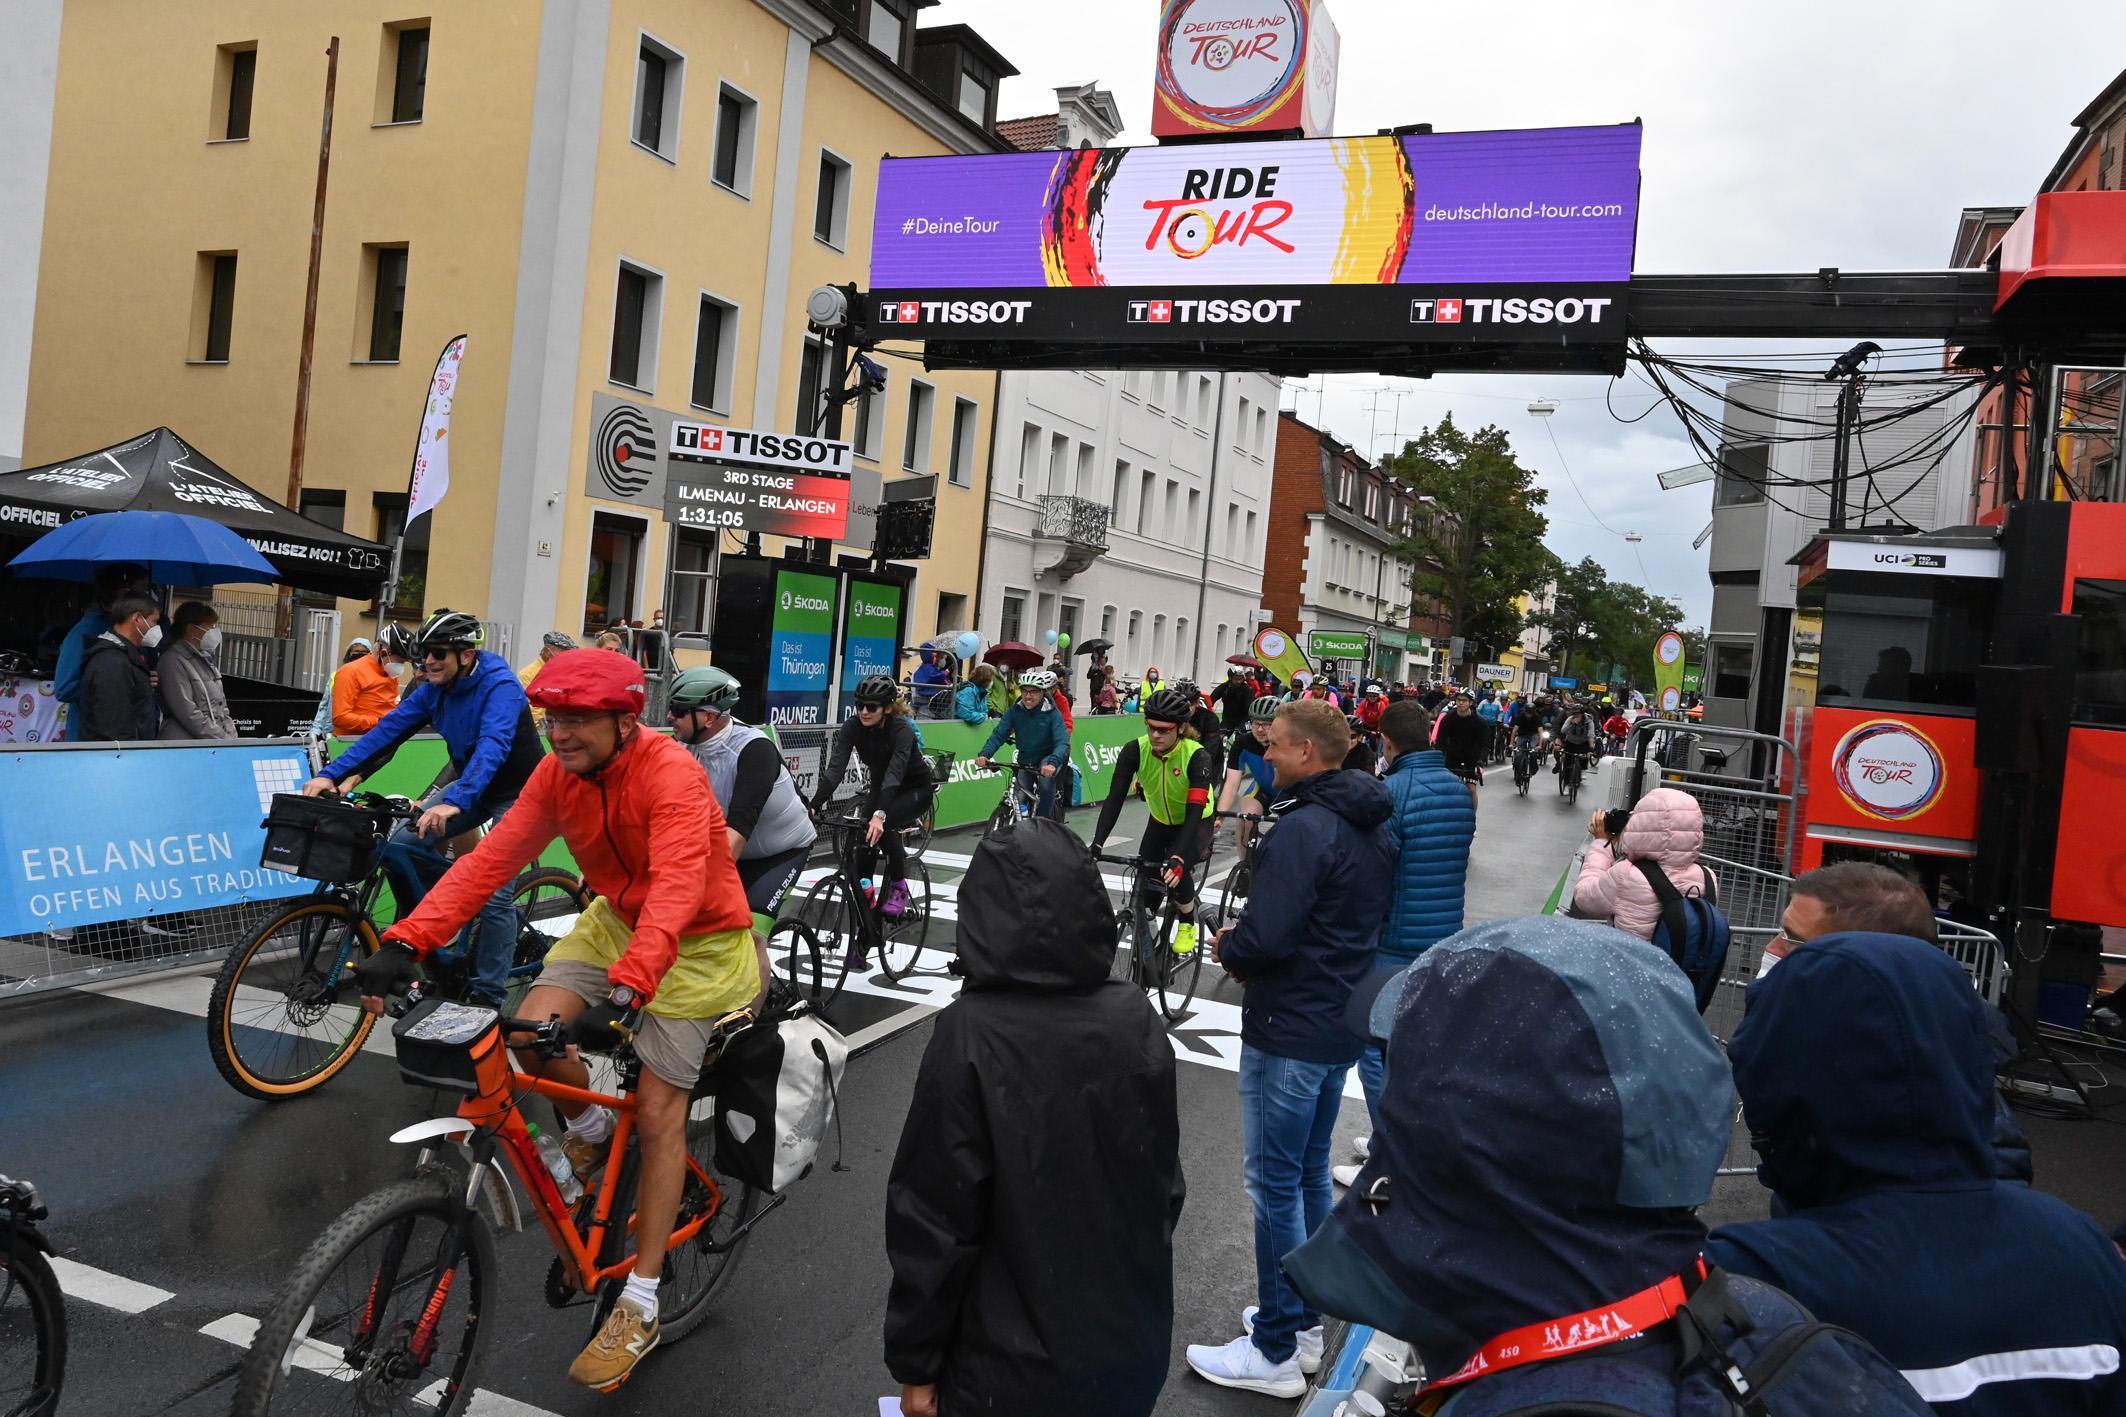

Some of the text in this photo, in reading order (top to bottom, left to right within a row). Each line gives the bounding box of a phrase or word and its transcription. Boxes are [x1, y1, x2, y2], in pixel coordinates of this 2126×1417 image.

[1183, 15, 1286, 35] DEUTSCHLAND
[1181, 166, 1280, 200] RIDE
[1425, 201, 1622, 221] deutschland-tour.com
[901, 216, 1000, 235] #DeineTour
[921, 301, 1032, 323] TISSOT
[1174, 299, 1301, 323] TISSOT
[1465, 298, 1611, 323] TISSOT
[727, 430, 849, 466] TISSOT
[26, 473, 113, 490] OFFICIEL
[48, 467, 126, 483] L'ATELIER
[723, 471, 794, 490] 3RD STAGE
[169, 481, 256, 503] L'ATELIER
[678, 485, 746, 505] ILMENAU
[759, 494, 836, 515] ERLANGEN
[174, 491, 275, 514] OFFICIEL
[0, 505, 63, 528] OFFICIEL
[678, 507, 743, 527] 1:31:05
[309, 548, 334, 562] MOI
[1874, 554, 1899, 563] UCI
[794, 595, 829, 611] ŠKODA
[864, 603, 894, 618] ŠKODA
[782, 641, 803, 654] Das ist
[854, 645, 864, 658] Das
[1326, 641, 1363, 651] ŠKODA
[781, 657, 825, 679] Thüringen
[1479, 667, 1511, 677] DAUNER
[770, 706, 818, 725] DAUNER
[1858, 757, 1917, 768] DEUTSCHLAND
[22, 831, 233, 882] ERLANGEN
[30, 885, 120, 916] OFFEN
[135, 875, 182, 903] AUS
[766, 886, 785, 912] PEARL
